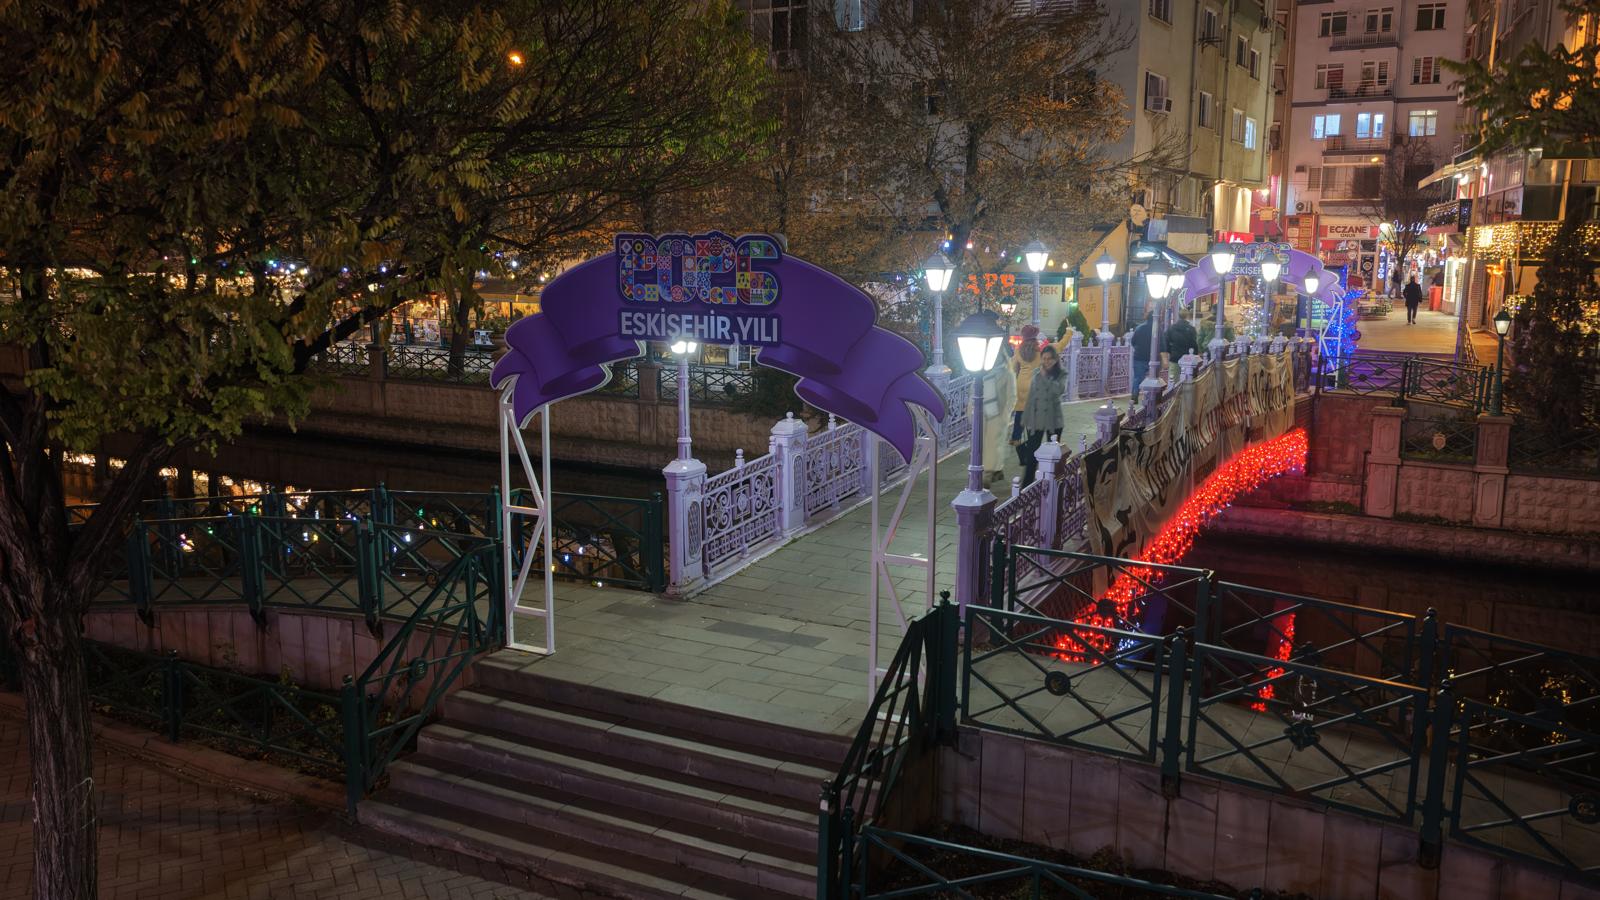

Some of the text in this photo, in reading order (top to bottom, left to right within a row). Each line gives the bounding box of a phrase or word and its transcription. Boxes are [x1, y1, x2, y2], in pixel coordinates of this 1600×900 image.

[1329, 225, 1367, 234] ECZANE
[619, 236, 779, 305] 2026
[620, 307, 778, 343] ESKİŞEHİR YILI
